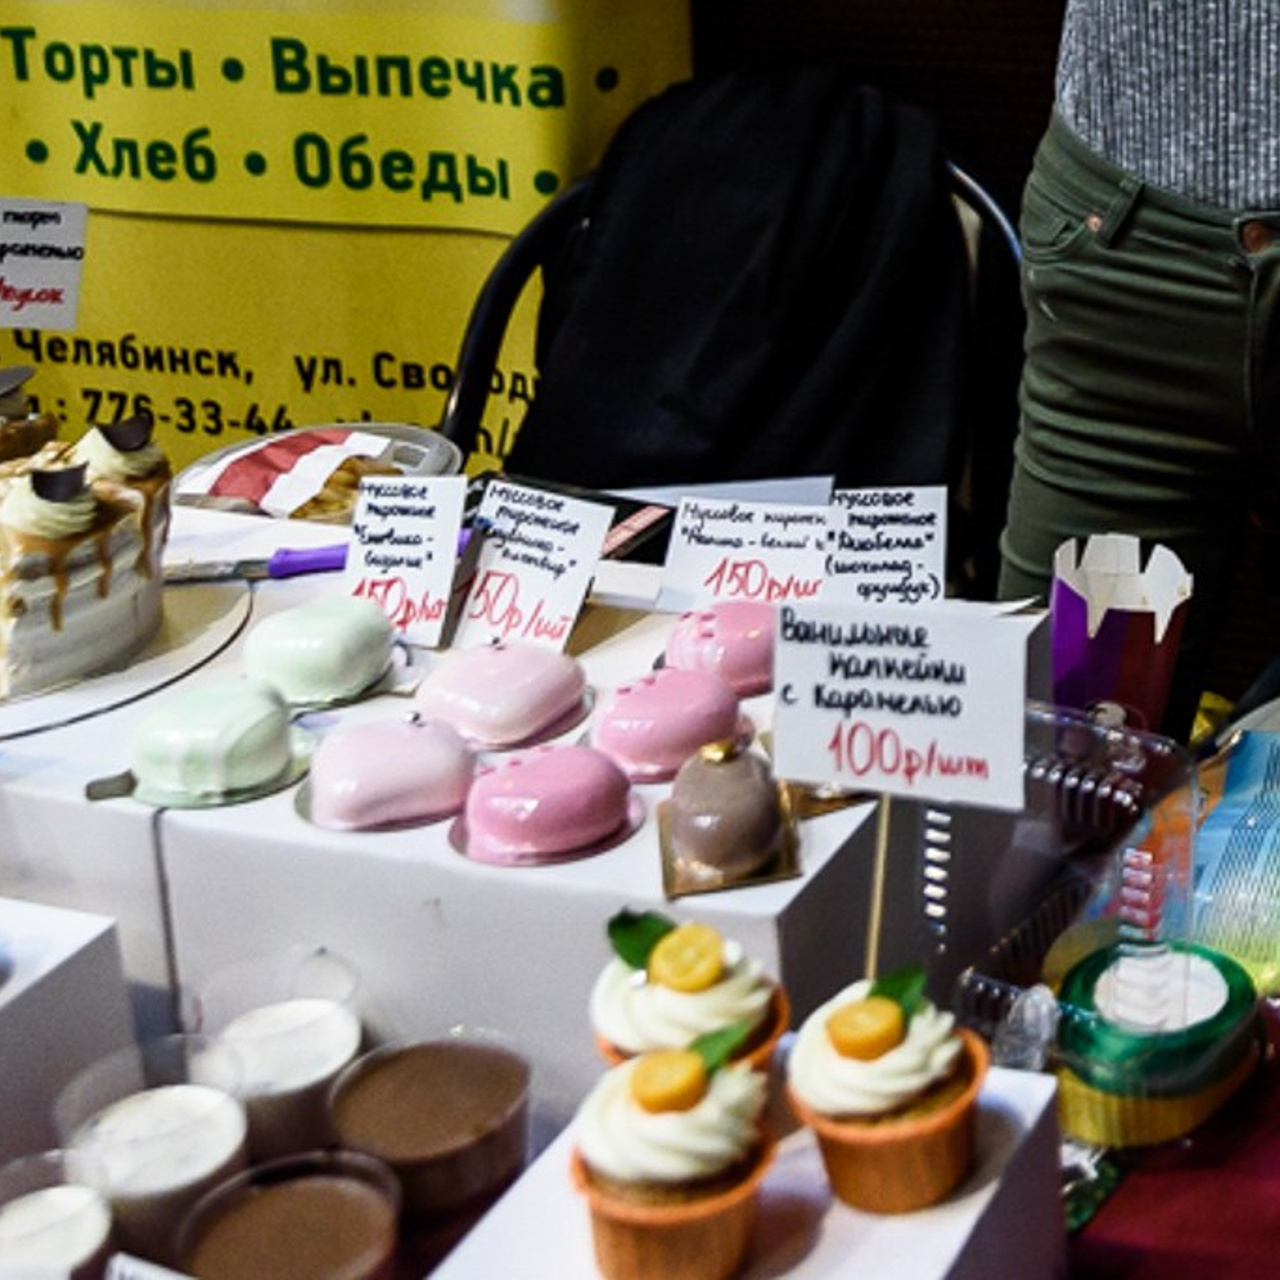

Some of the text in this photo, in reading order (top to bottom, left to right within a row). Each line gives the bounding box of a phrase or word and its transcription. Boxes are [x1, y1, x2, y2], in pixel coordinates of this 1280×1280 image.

[0, 27, 566, 108] Торты Выпечка
[71, 120, 510, 202] Хлеб Обеды
[12, 328, 541, 405] Челябинск, ул. Своод
